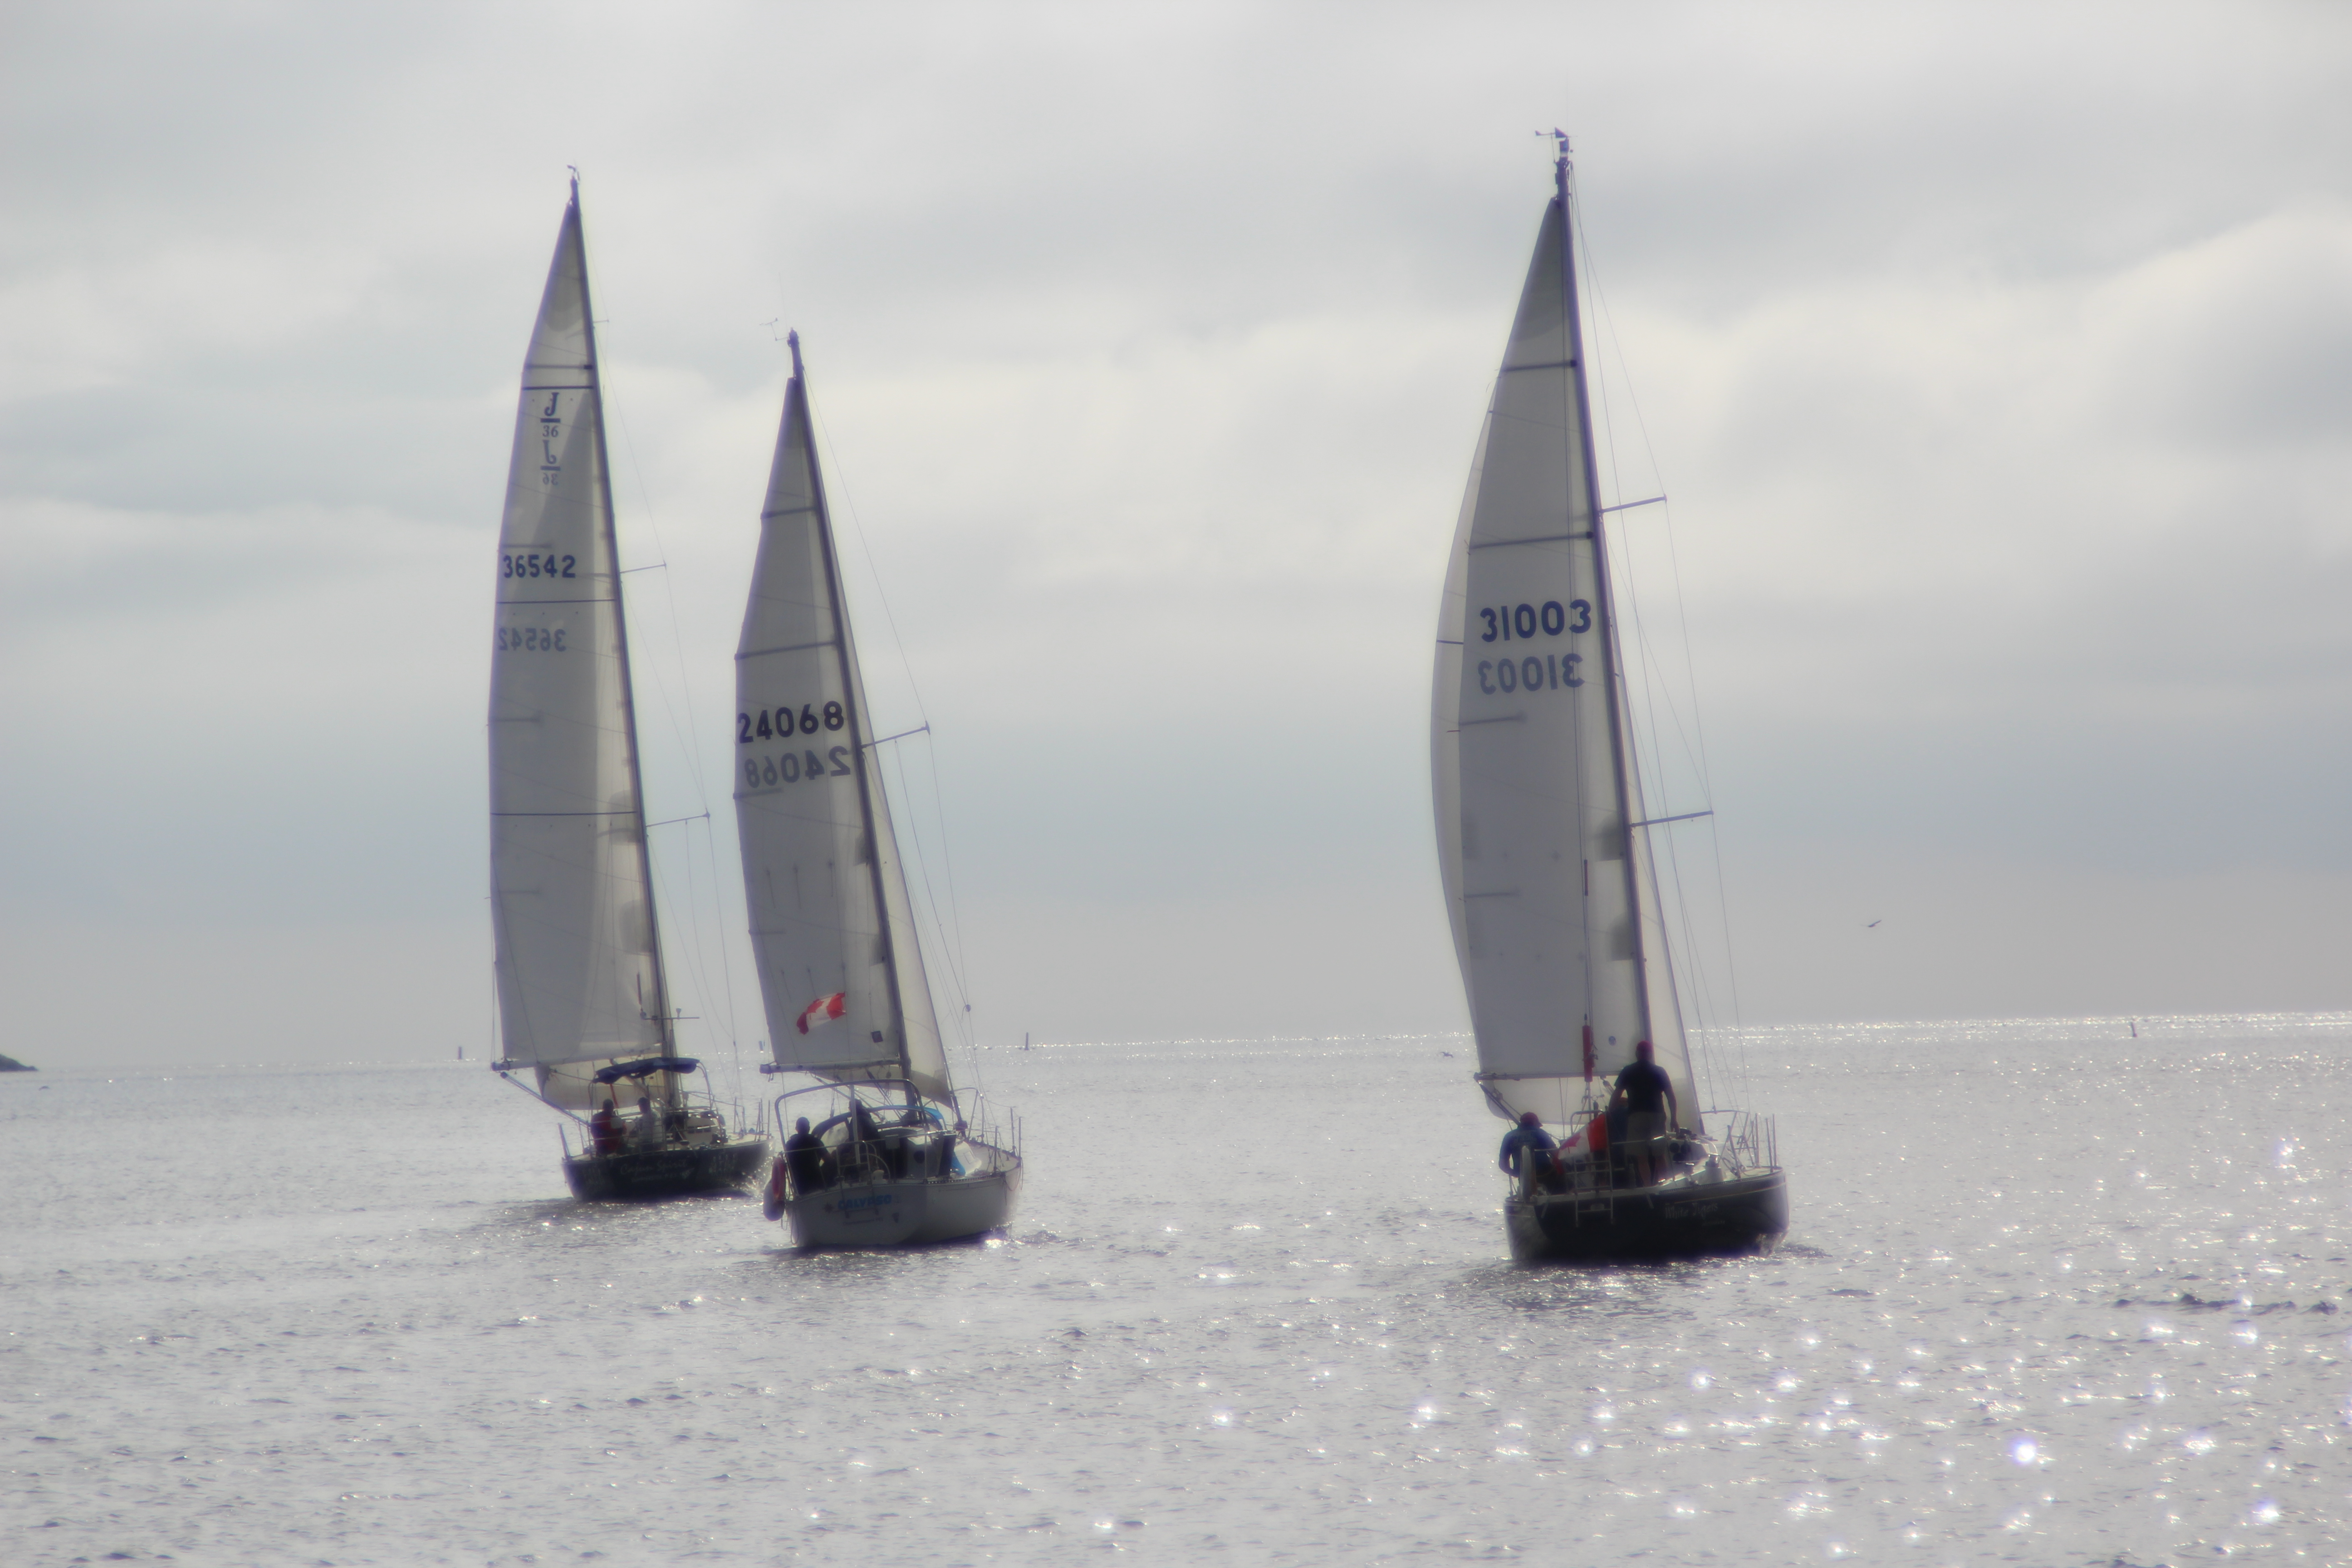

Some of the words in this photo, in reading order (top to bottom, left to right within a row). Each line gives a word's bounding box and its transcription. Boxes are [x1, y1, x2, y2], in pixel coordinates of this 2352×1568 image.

[544, 392, 559, 416] J
[542, 425, 559, 438] 36
[503, 554, 576, 579] 36542
[1480, 598, 1592, 643] 31003
[737, 701, 844, 744] 24068
[838, 1194, 892, 1211] CALYPSO
[1665, 1205, 1689, 1219] White
